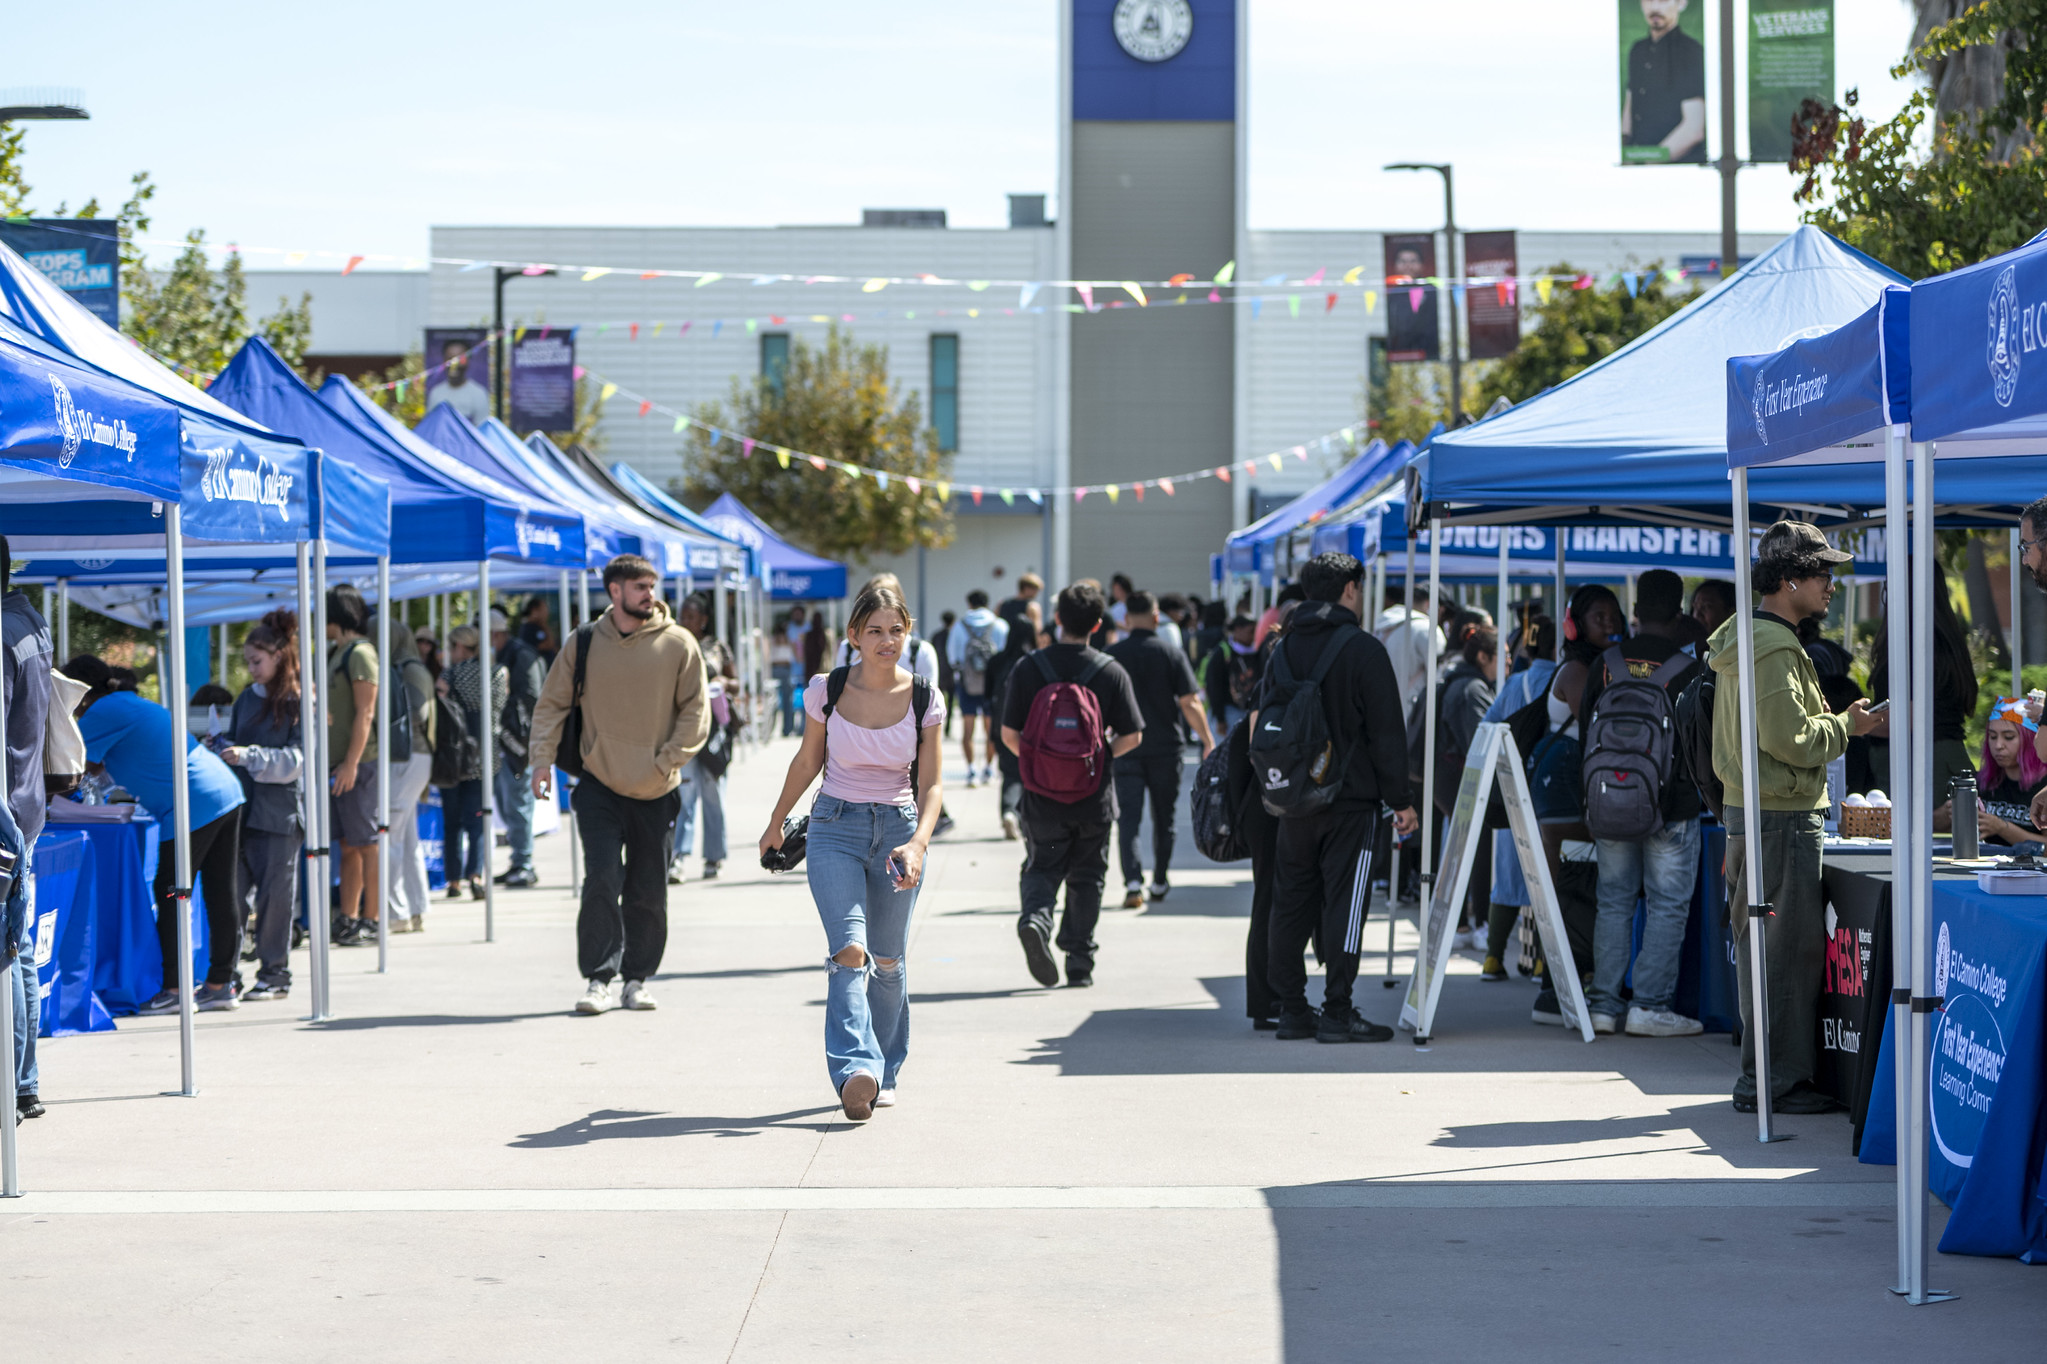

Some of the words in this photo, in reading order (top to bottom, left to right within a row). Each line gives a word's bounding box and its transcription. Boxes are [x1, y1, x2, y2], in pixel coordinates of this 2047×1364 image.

[46, 266, 109, 288] GRAM
[1765, 382, 1780, 418] First
[1780, 378, 1793, 412] Year
[1792, 367, 1828, 417] Experience
[86, 411, 115, 447] Camino
[1825, 928, 1864, 998] MESA
[1950, 950, 1958, 979] El
[1956, 952, 1980, 990] Camino
[1979, 963, 2007, 1008] College
[1822, 1018, 1837, 1050] El
[1942, 1015, 1956, 1059] First
[1954, 1022, 1969, 1066] Year
[1940, 1063, 1966, 1107] Learning
